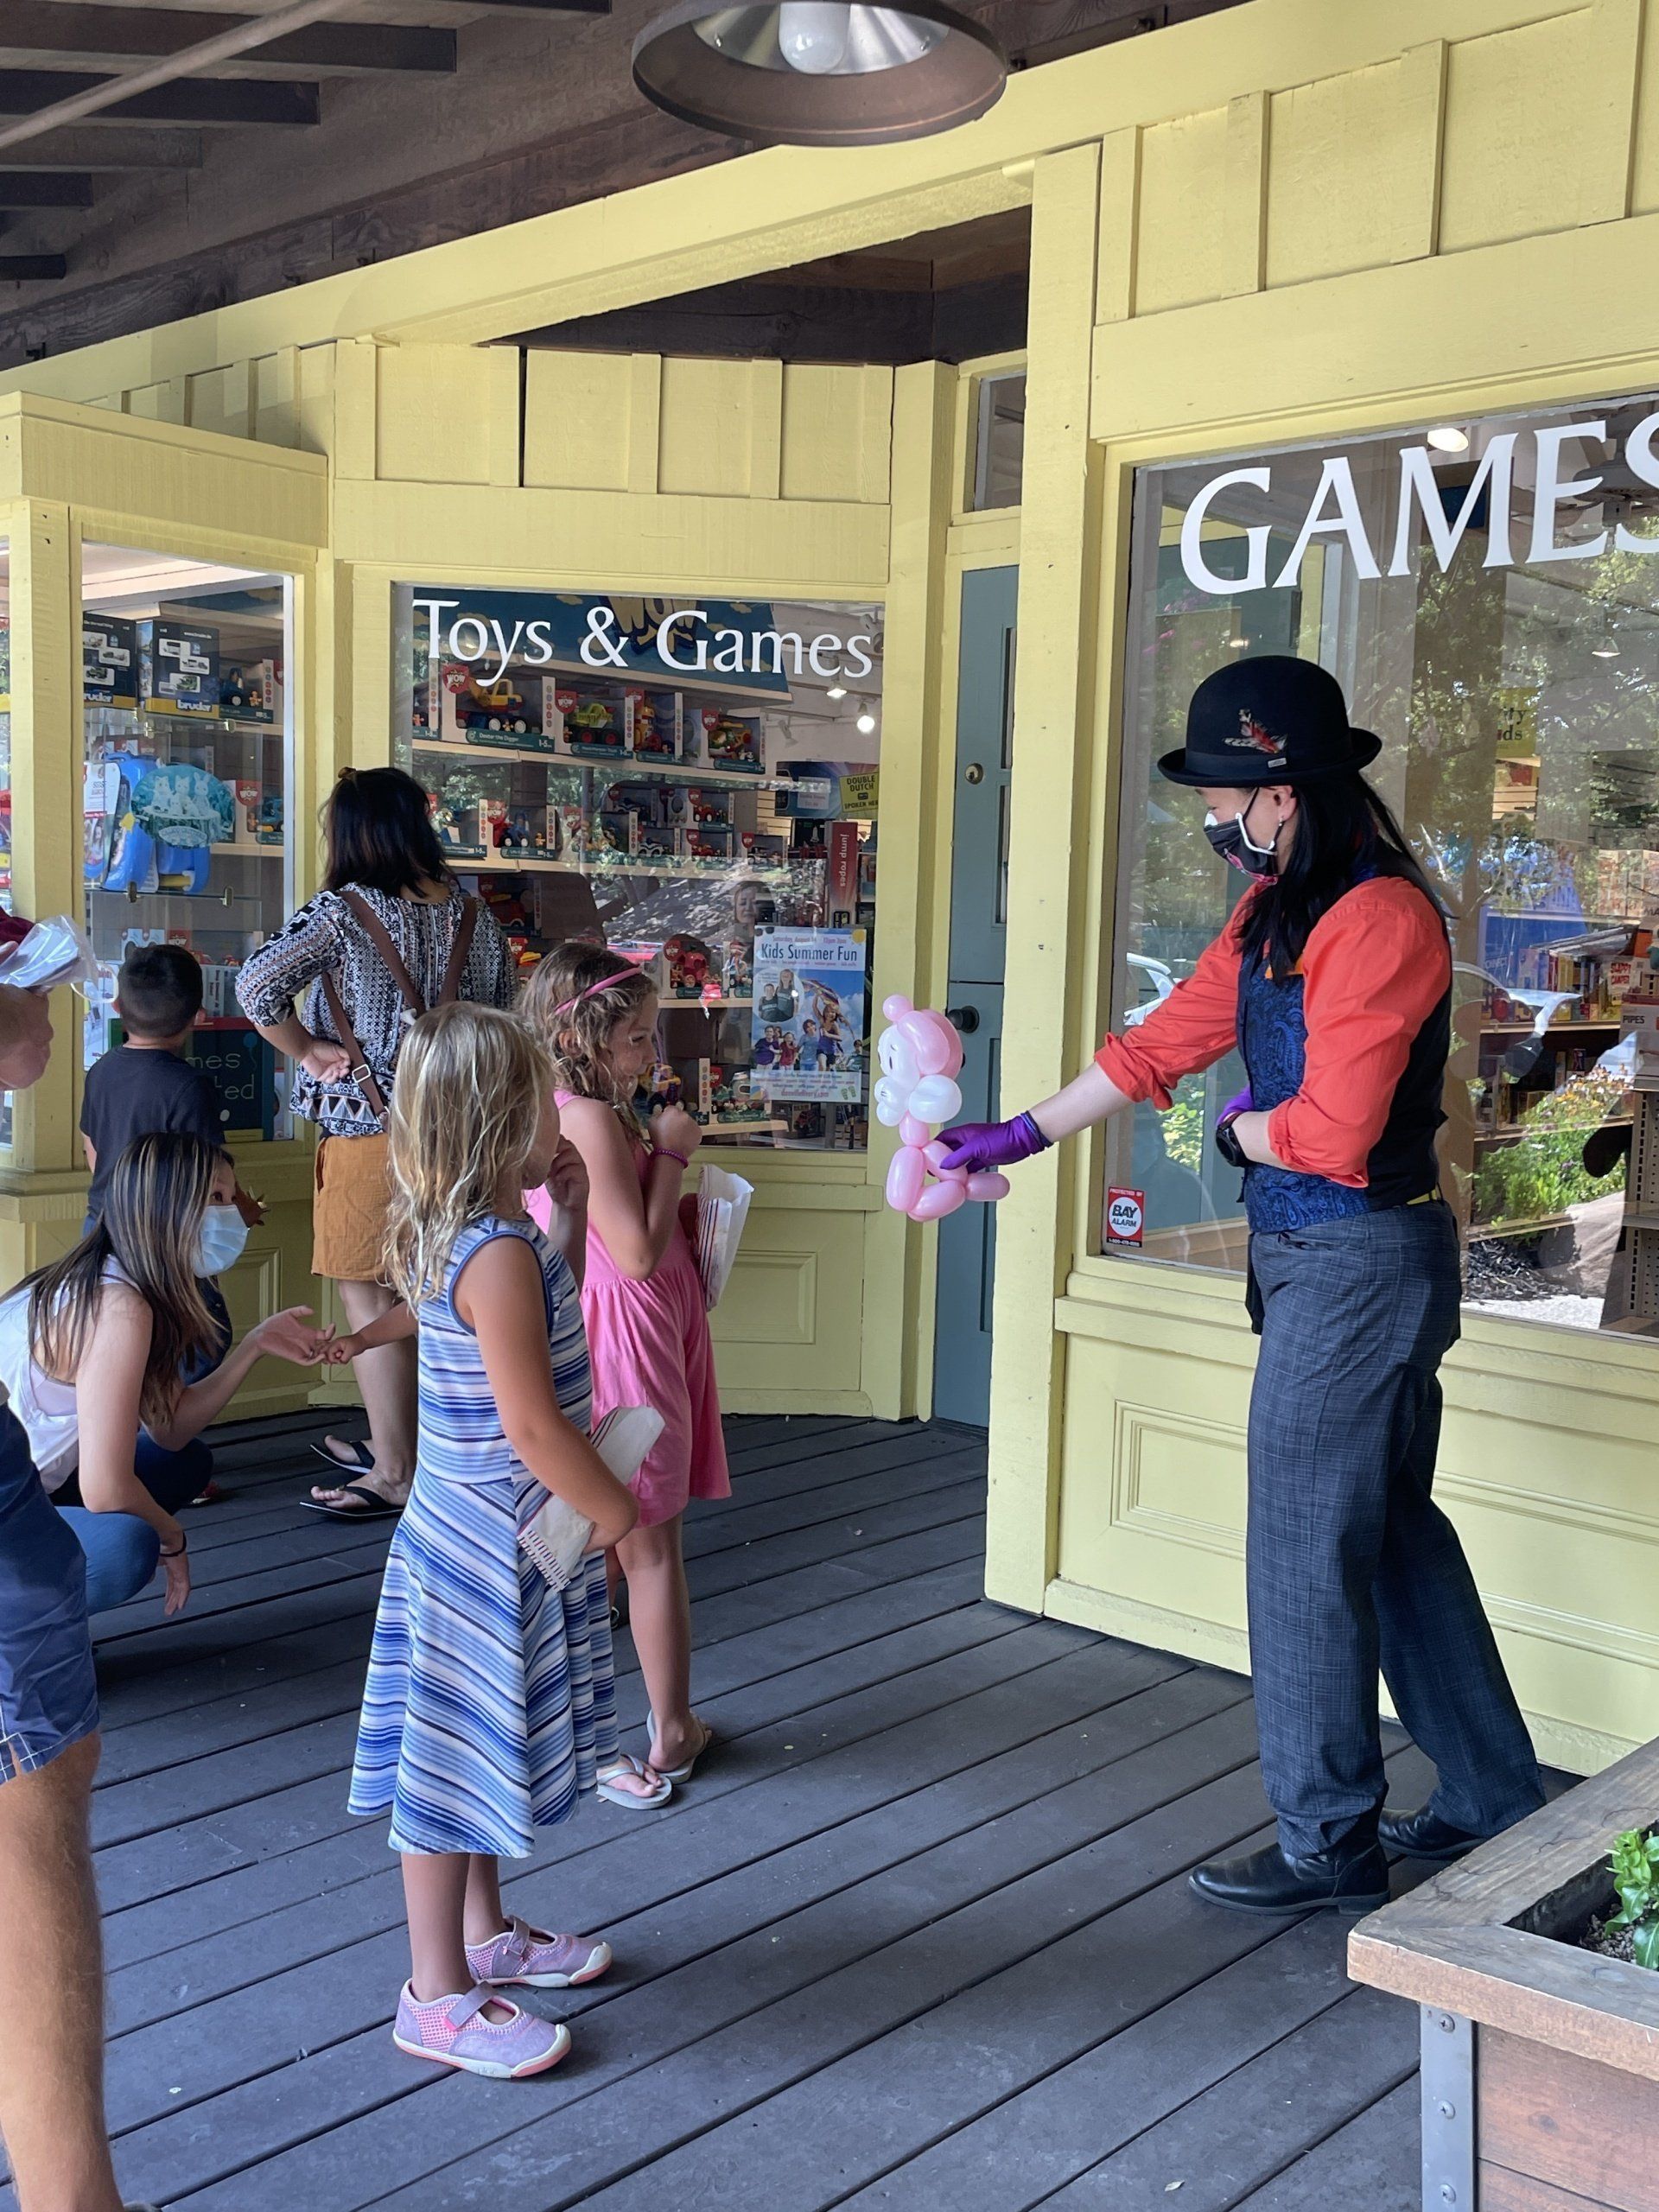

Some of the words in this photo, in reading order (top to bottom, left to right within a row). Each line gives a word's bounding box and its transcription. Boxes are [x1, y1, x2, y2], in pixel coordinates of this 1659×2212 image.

[412, 599, 553, 688] Toys
[580, 606, 629, 668] &
[656, 610, 873, 679] Games
[446, 673, 466, 684] WOW
[847, 775, 875, 785] DOUBLE
[849, 783, 874, 791] DUTCH
[838, 834, 849, 859] jump
[839, 861, 848, 887] ropes
[761, 943, 785, 959] Kids
[787, 944, 834, 961] Summer
[837, 946, 857, 962] Fun
[1622, 1015, 1645, 1024] PIPES
[1112, 1204, 1139, 1218] BAY
[1111, 1217, 1137, 1228] ALARM
